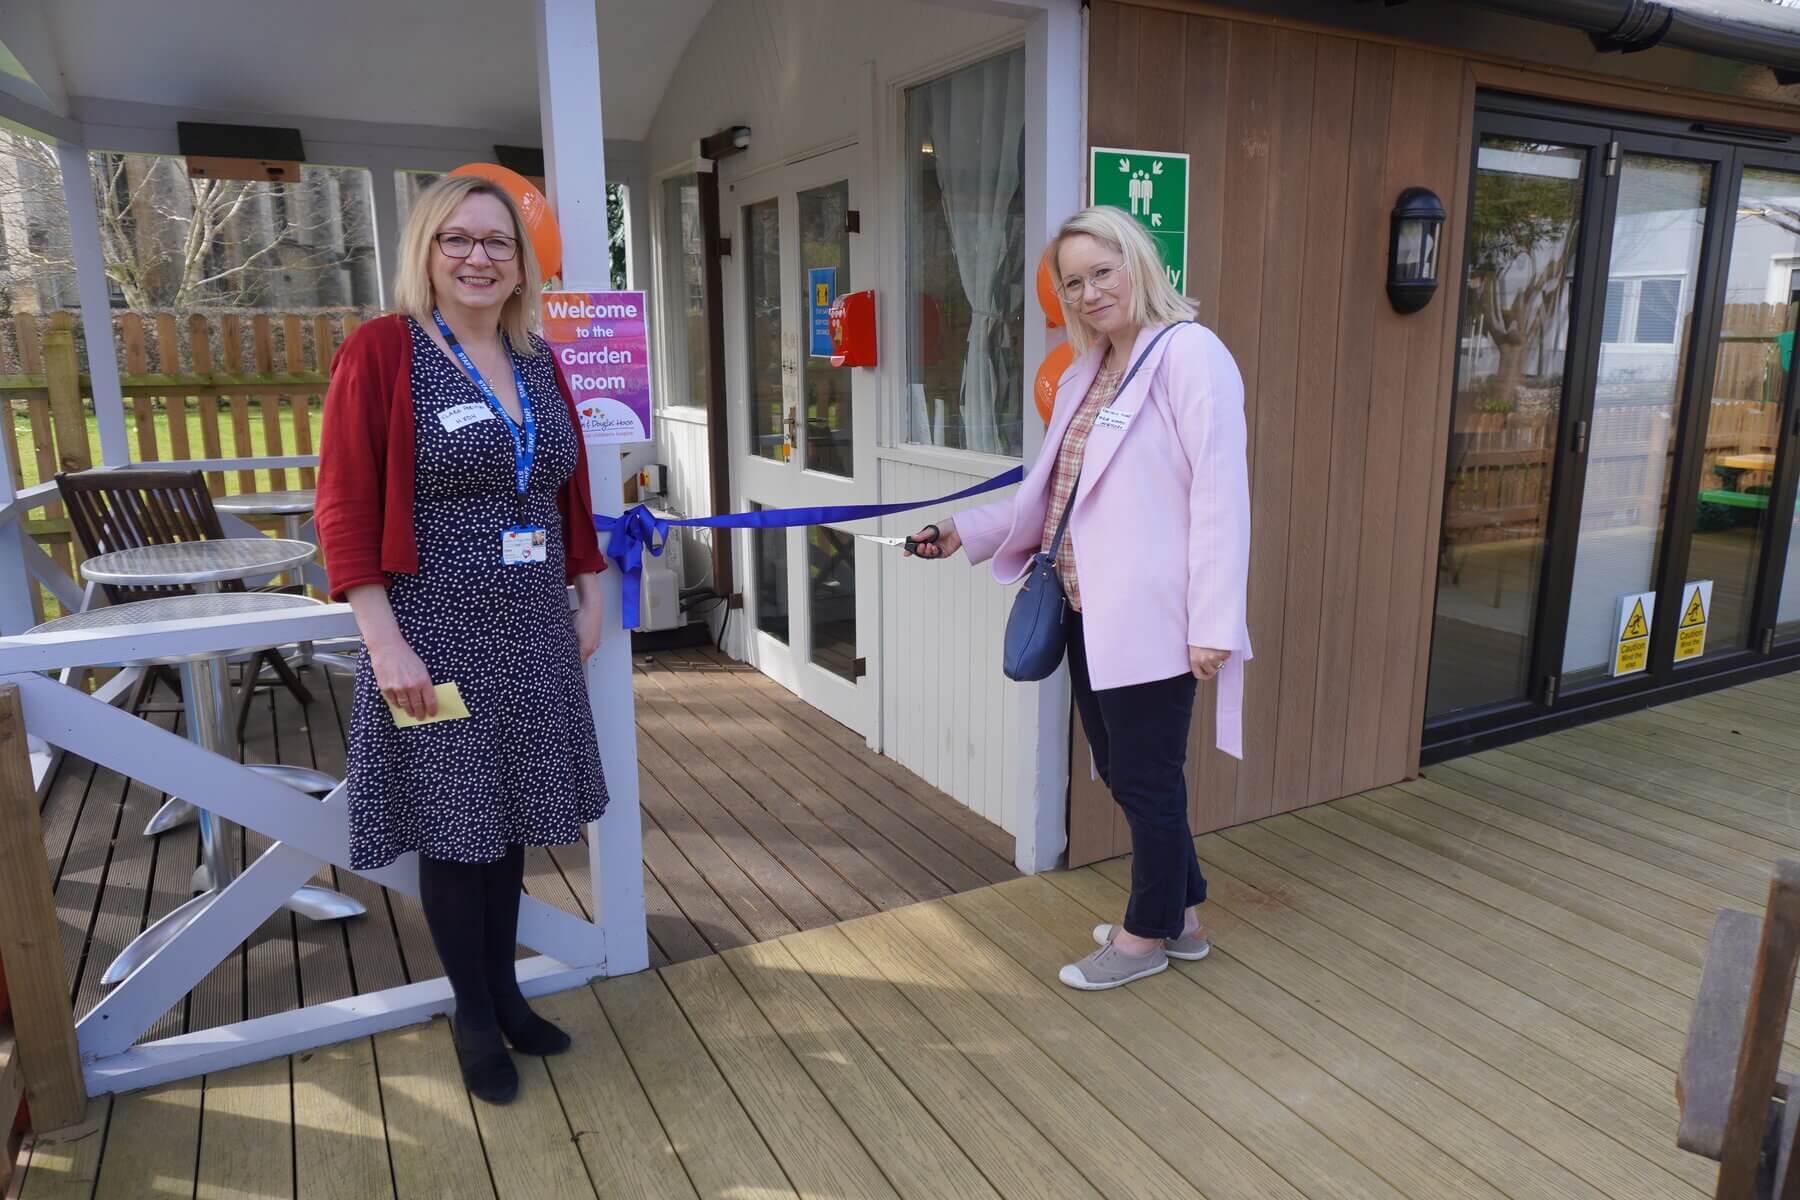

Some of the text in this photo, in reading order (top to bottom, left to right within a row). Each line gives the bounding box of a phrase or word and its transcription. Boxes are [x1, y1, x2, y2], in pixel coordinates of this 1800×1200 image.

[547, 301, 638, 319] Welcome
[575, 326, 614, 338] to the
[457, 352, 475, 370] STAFF
[561, 346, 632, 365] Garden
[476, 379, 494, 397] STAFF
[571, 374, 626, 390] Room
[524, 407, 535, 422] STAFF
[527, 432, 536, 453] STAFF
[517, 470, 525, 492] STAFF
[1680, 629, 1703, 641] Caution
[1621, 642, 1646, 654] Caution
